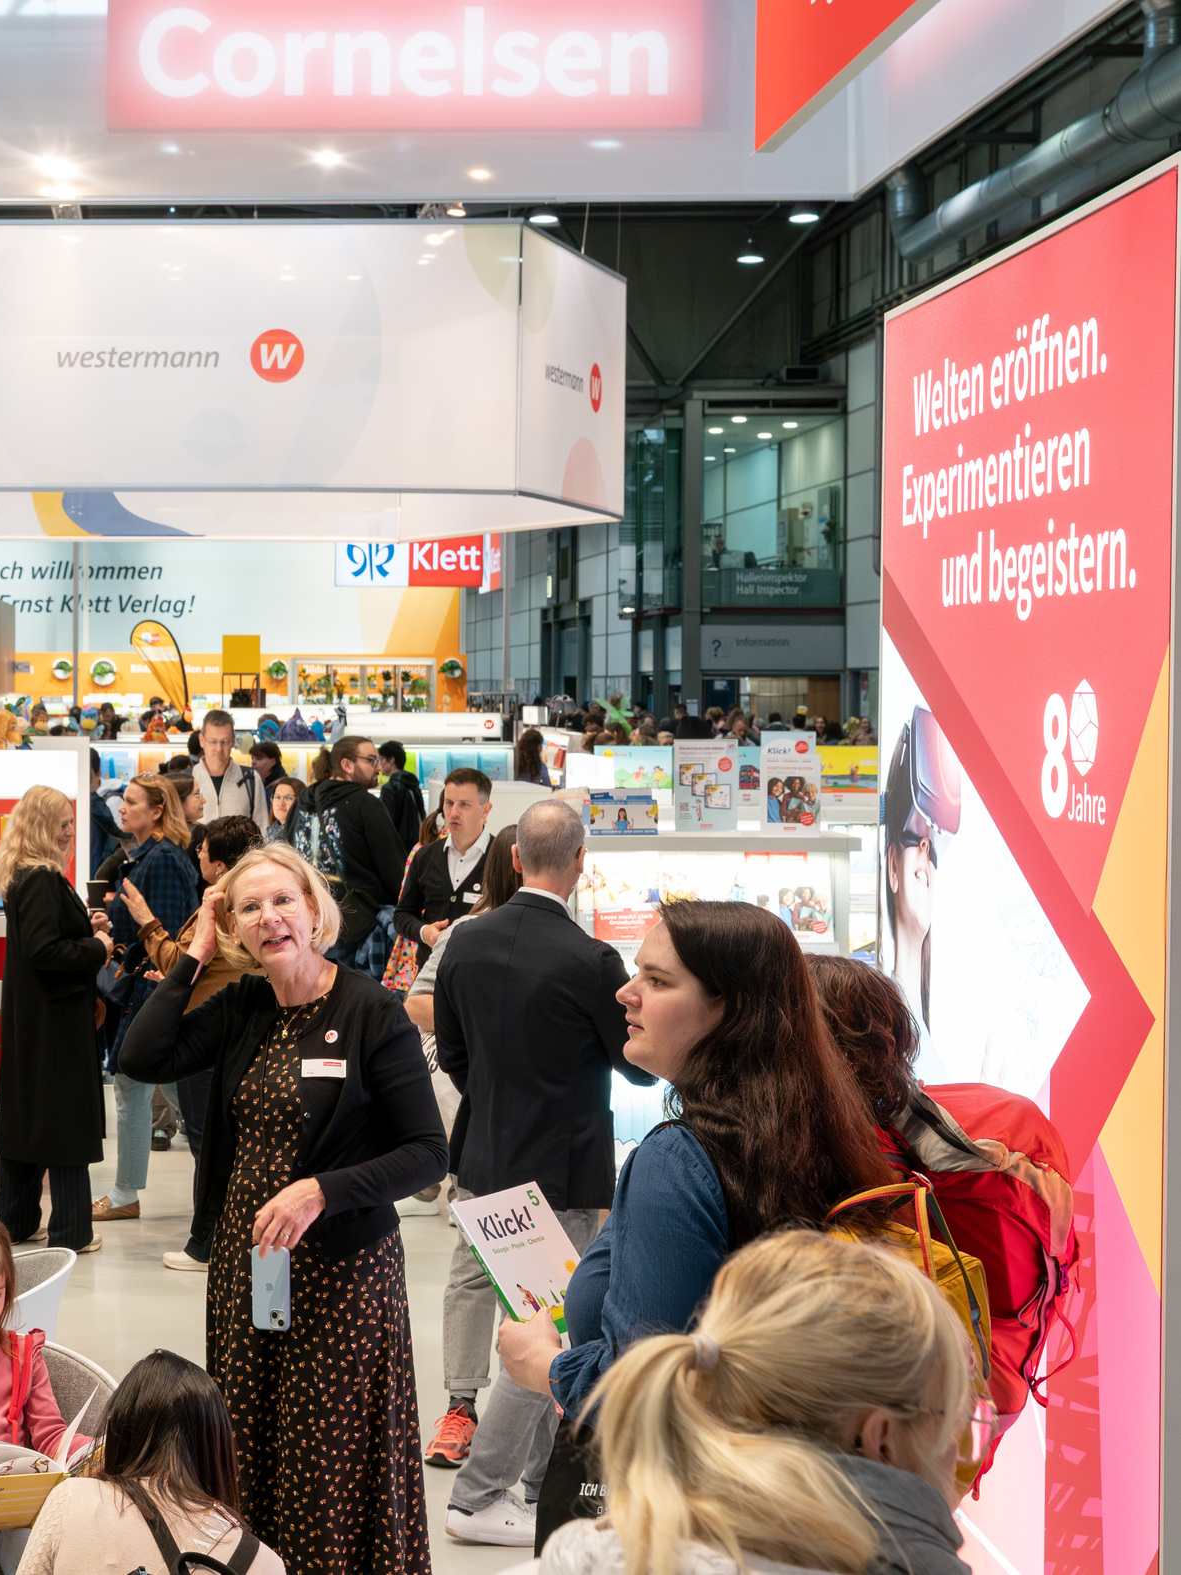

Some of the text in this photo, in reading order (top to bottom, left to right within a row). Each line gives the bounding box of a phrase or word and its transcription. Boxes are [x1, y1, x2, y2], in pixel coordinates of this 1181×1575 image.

[138, 6, 669, 99] Cornelsen
[56, 347, 220, 368] westermann
[544, 363, 584, 394] westermann
[913, 313, 1107, 437] Welten eröffnen.
[902, 422, 1091, 540] Experimentieren
[412, 542, 481, 571] Klett
[736, 572, 807, 584] Halleninspektor
[942, 518, 1137, 622] und begeistern.
[736, 585, 800, 597] Hall Inspector
[118, 595, 195, 618] Verlag!
[736, 636, 790, 647] Information
[203, 666, 220, 674] aus
[767, 747, 791, 755] Klick!
[1067, 782, 1107, 826] Jahre
[526, 1189, 540, 1206] 5
[477, 1205, 536, 1241] Klick!
[511, 1239, 526, 1250] Physik
[527, 1234, 546, 1245] Chemie
[579, 1482, 598, 1496] ICH
